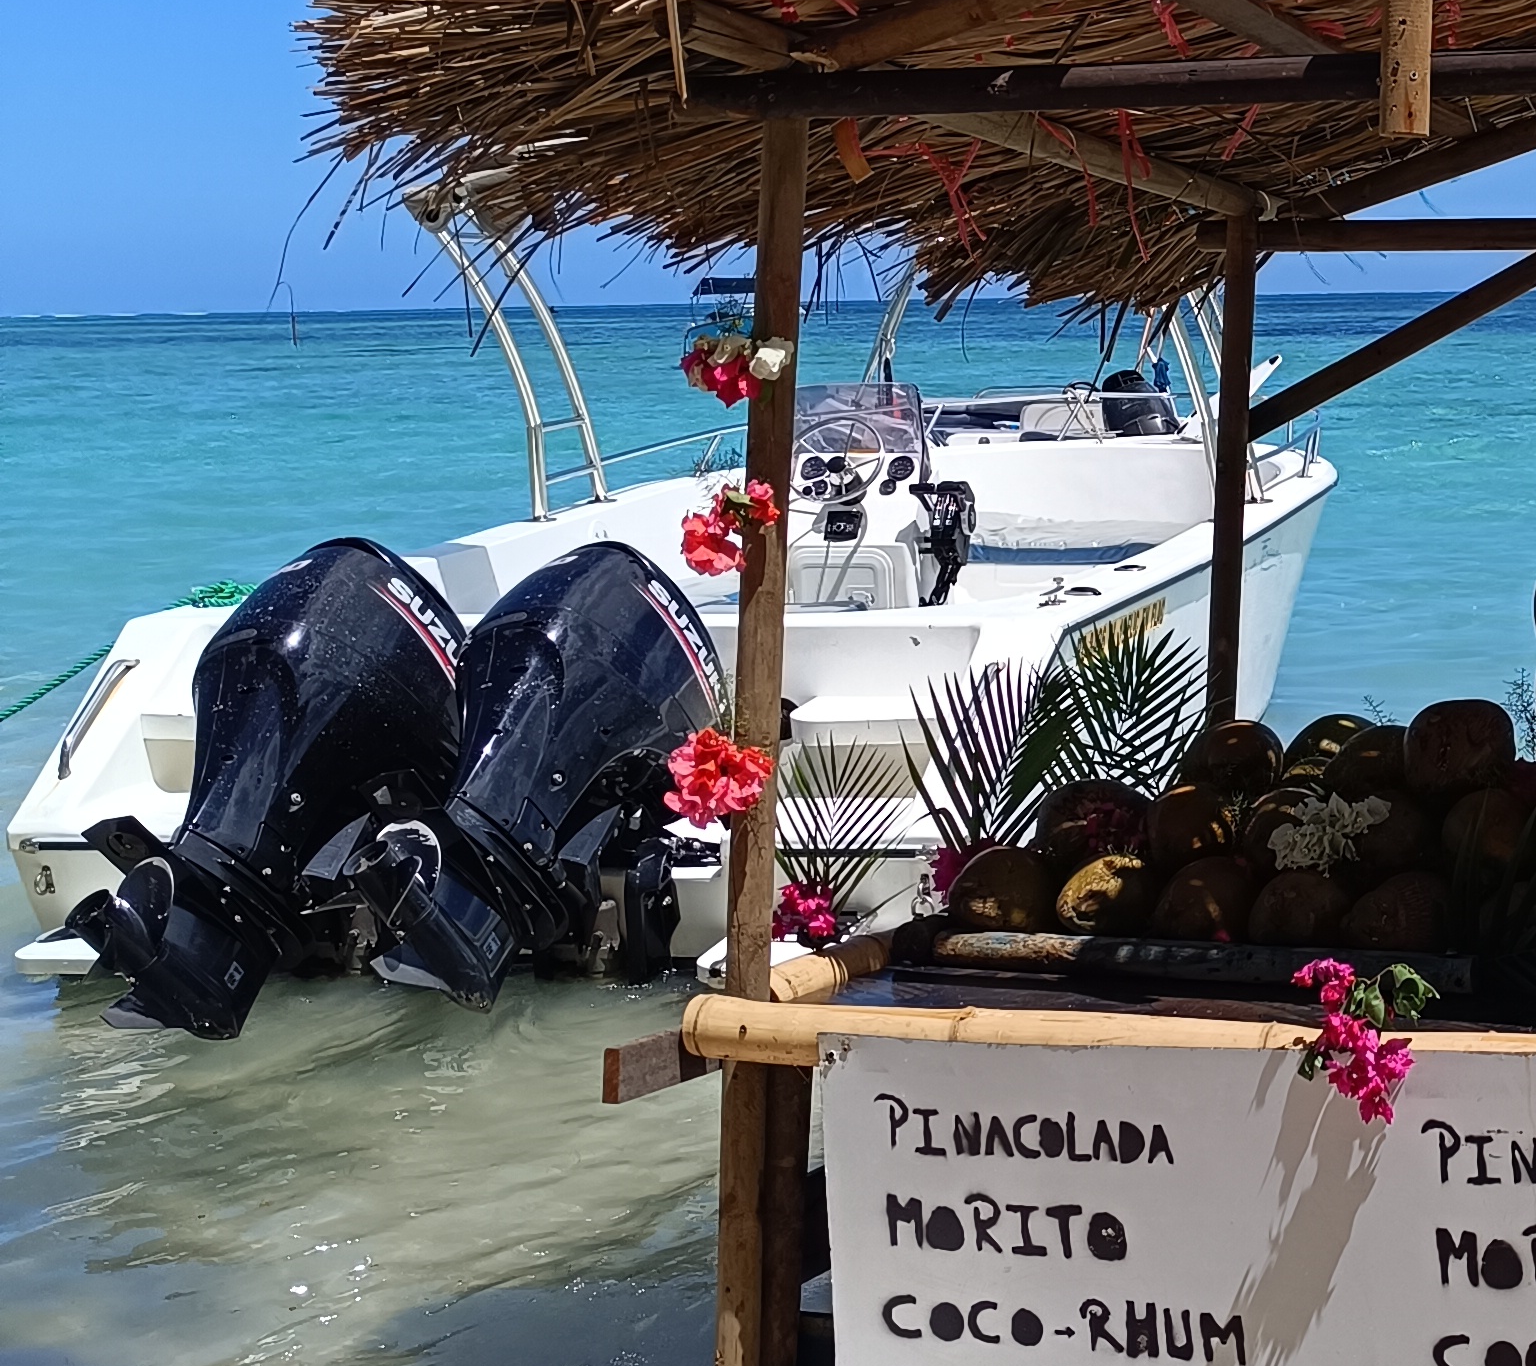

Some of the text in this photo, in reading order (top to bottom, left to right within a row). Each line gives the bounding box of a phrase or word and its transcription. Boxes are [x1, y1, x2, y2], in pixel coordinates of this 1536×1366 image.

[387, 577, 458, 668] SUZU
[873, 1093, 1174, 1165] PINACOLADA
[885, 1192, 1128, 1262] MORITO
